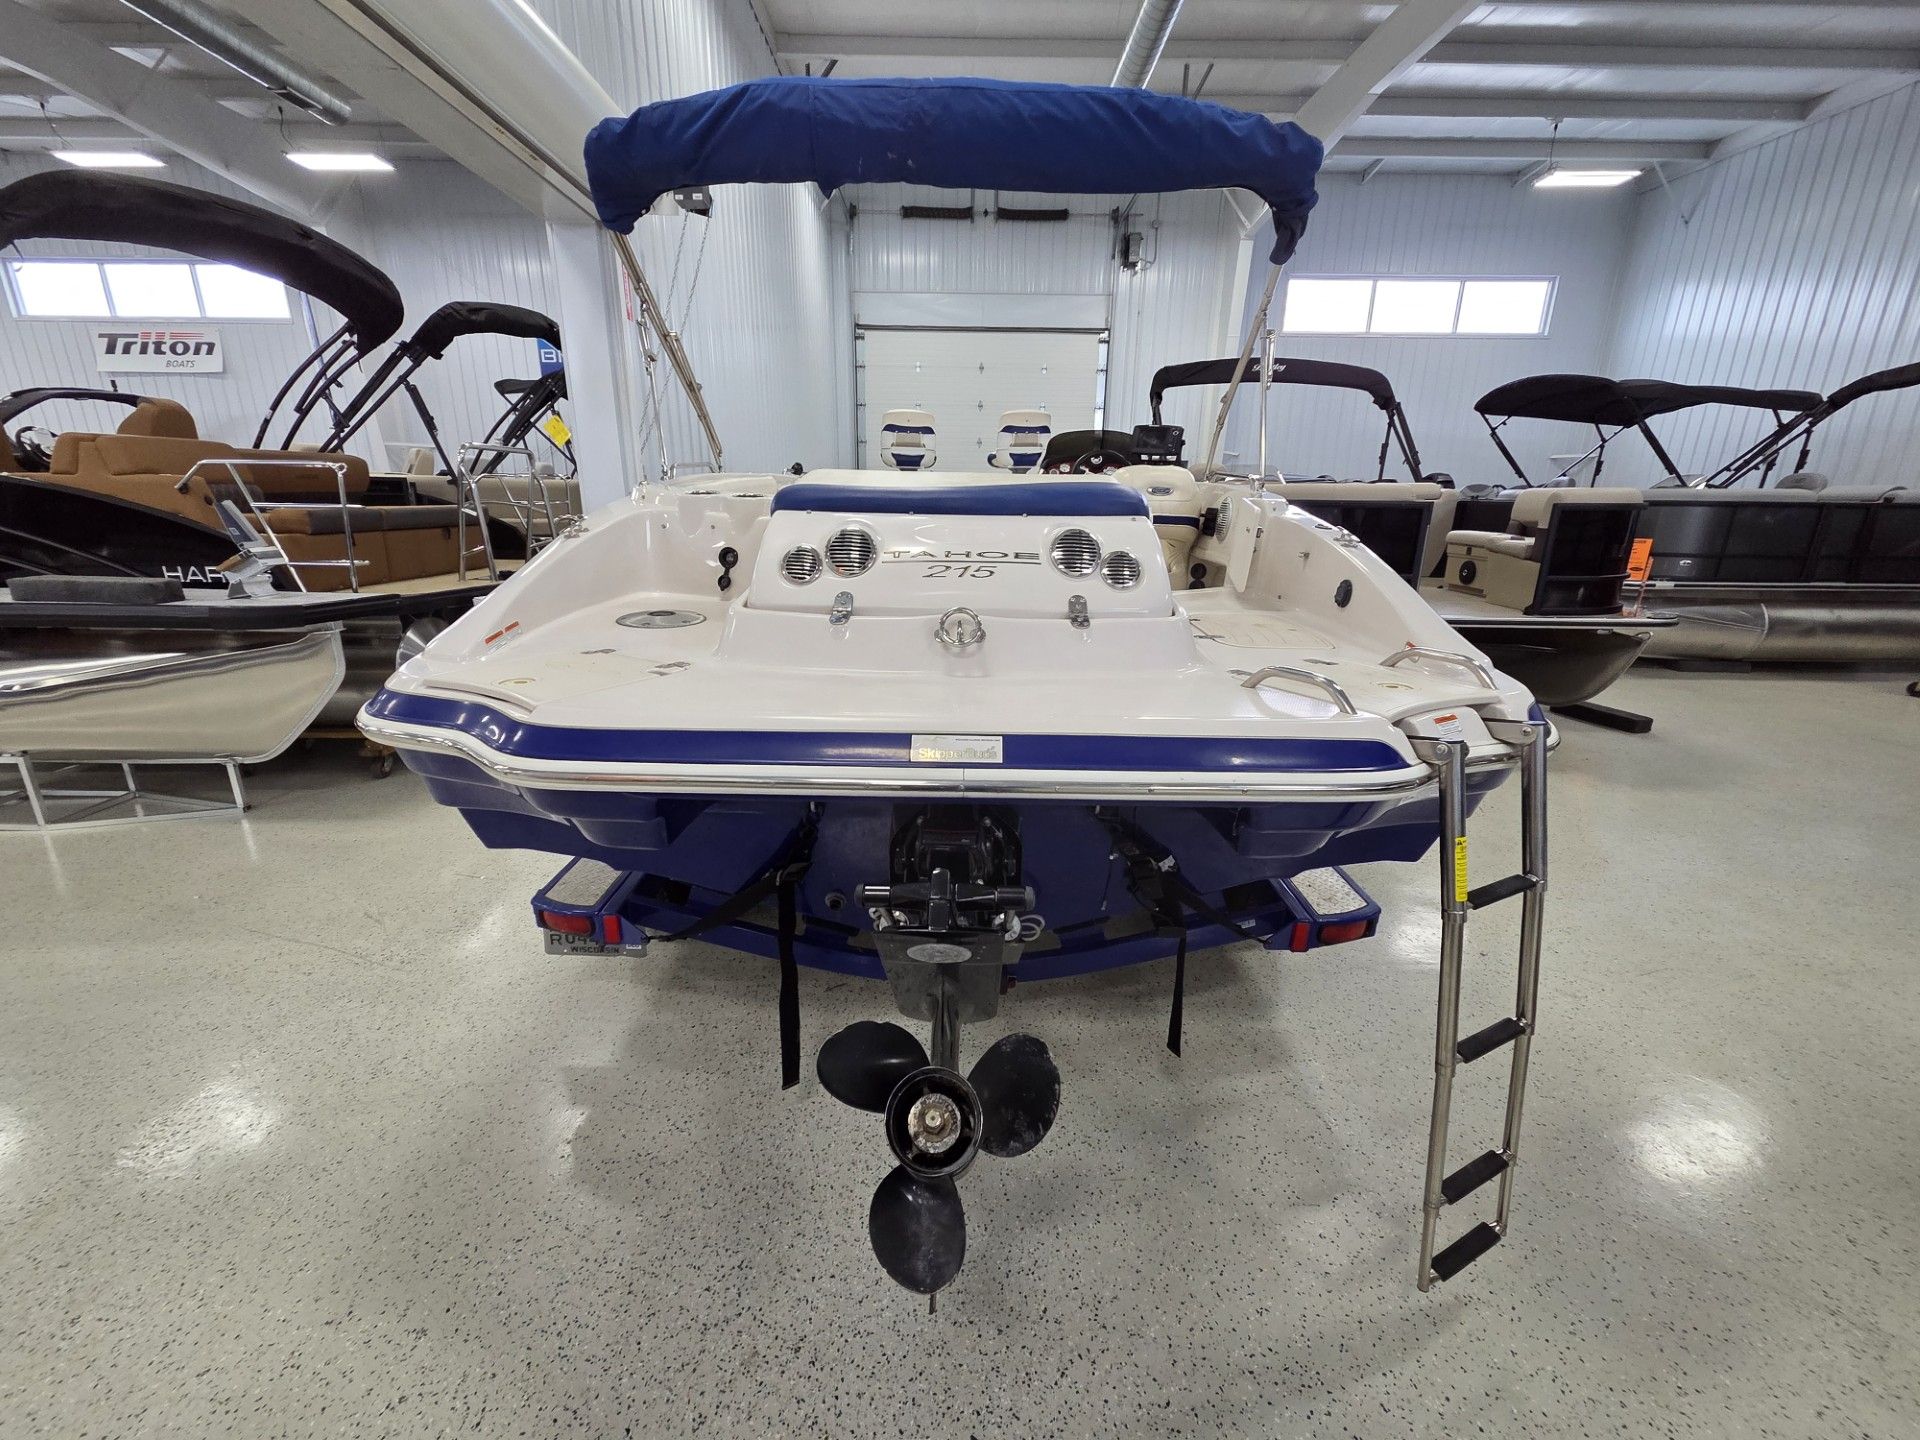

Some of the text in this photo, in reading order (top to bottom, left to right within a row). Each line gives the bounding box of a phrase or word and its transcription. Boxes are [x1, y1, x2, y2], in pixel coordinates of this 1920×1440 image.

[98, 332, 216, 356] Triton
[165, 360, 196, 368] BOATS
[883, 550, 1040, 560] TAHOE
[161, 565, 227, 583] HAR
[922, 564, 997, 578] 215
